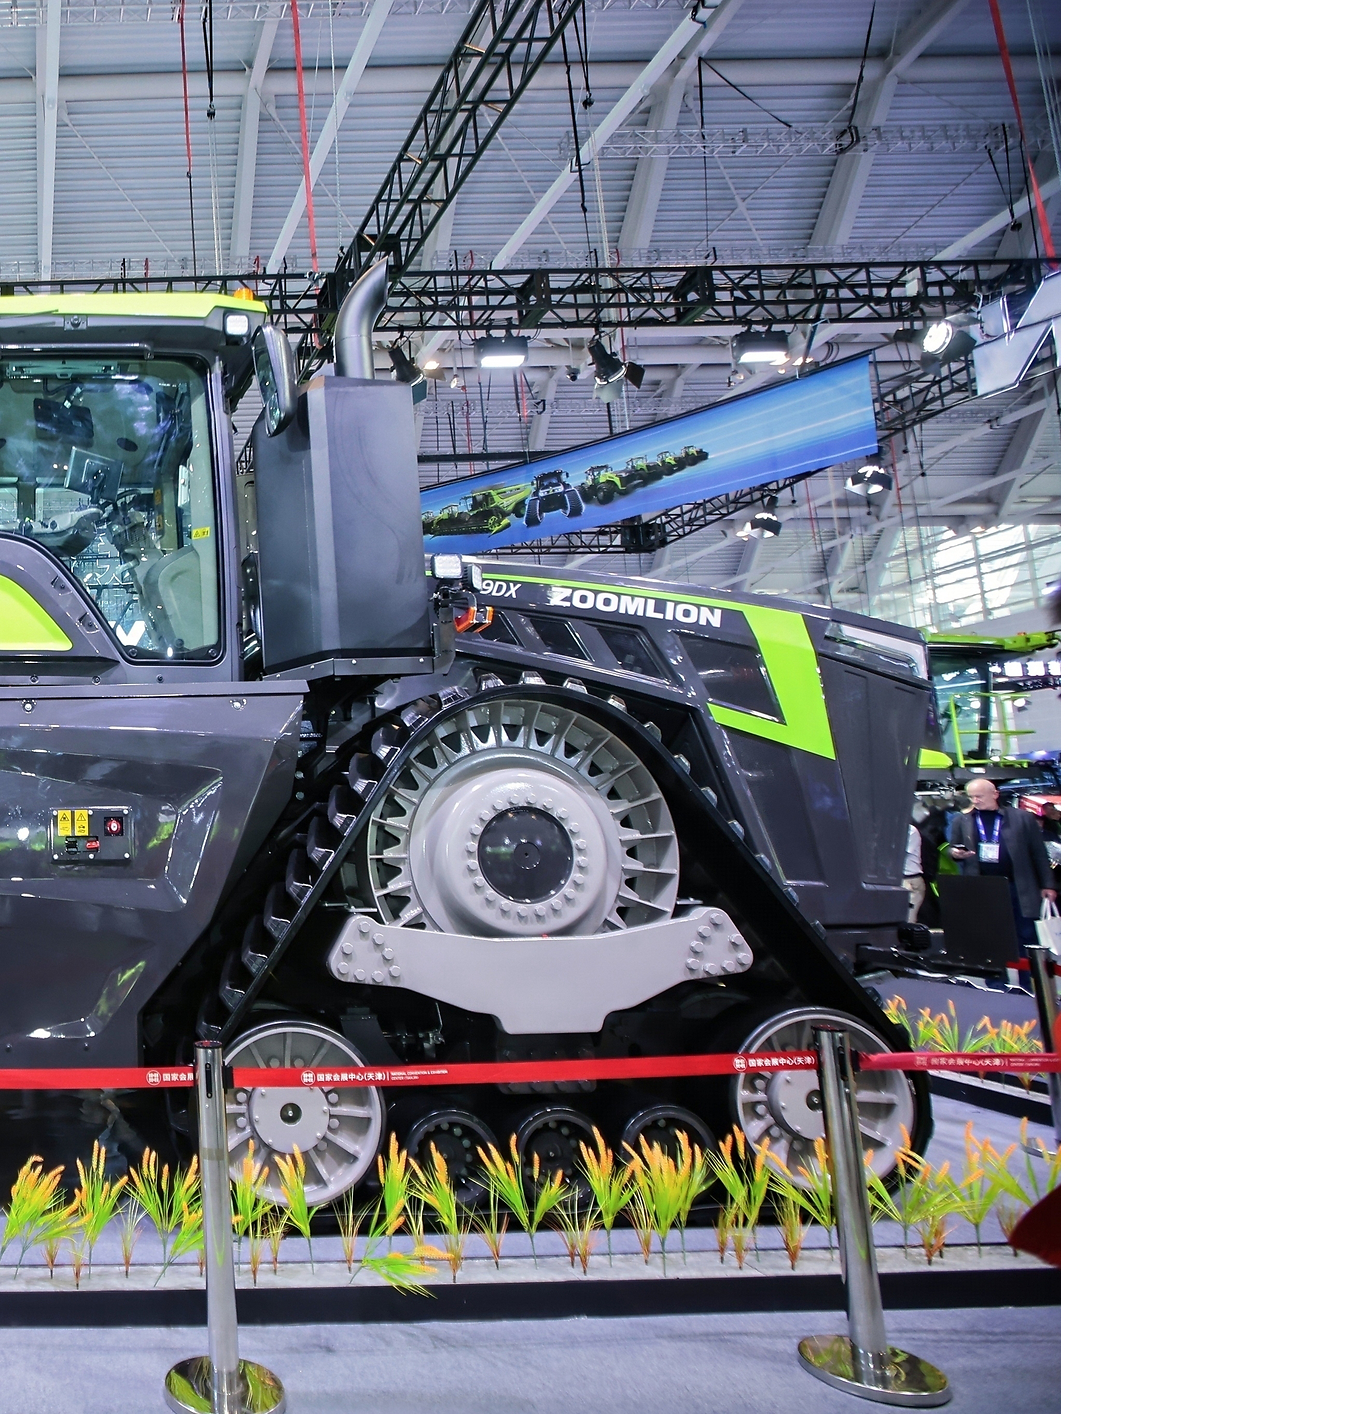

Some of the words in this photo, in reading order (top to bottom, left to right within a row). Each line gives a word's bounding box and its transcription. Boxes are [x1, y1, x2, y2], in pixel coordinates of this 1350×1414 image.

[480, 580, 522, 598] 9DX
[548, 587, 722, 628] ZOOMLION
[317, 1071, 386, 1082] 国家会展中心(天津)
